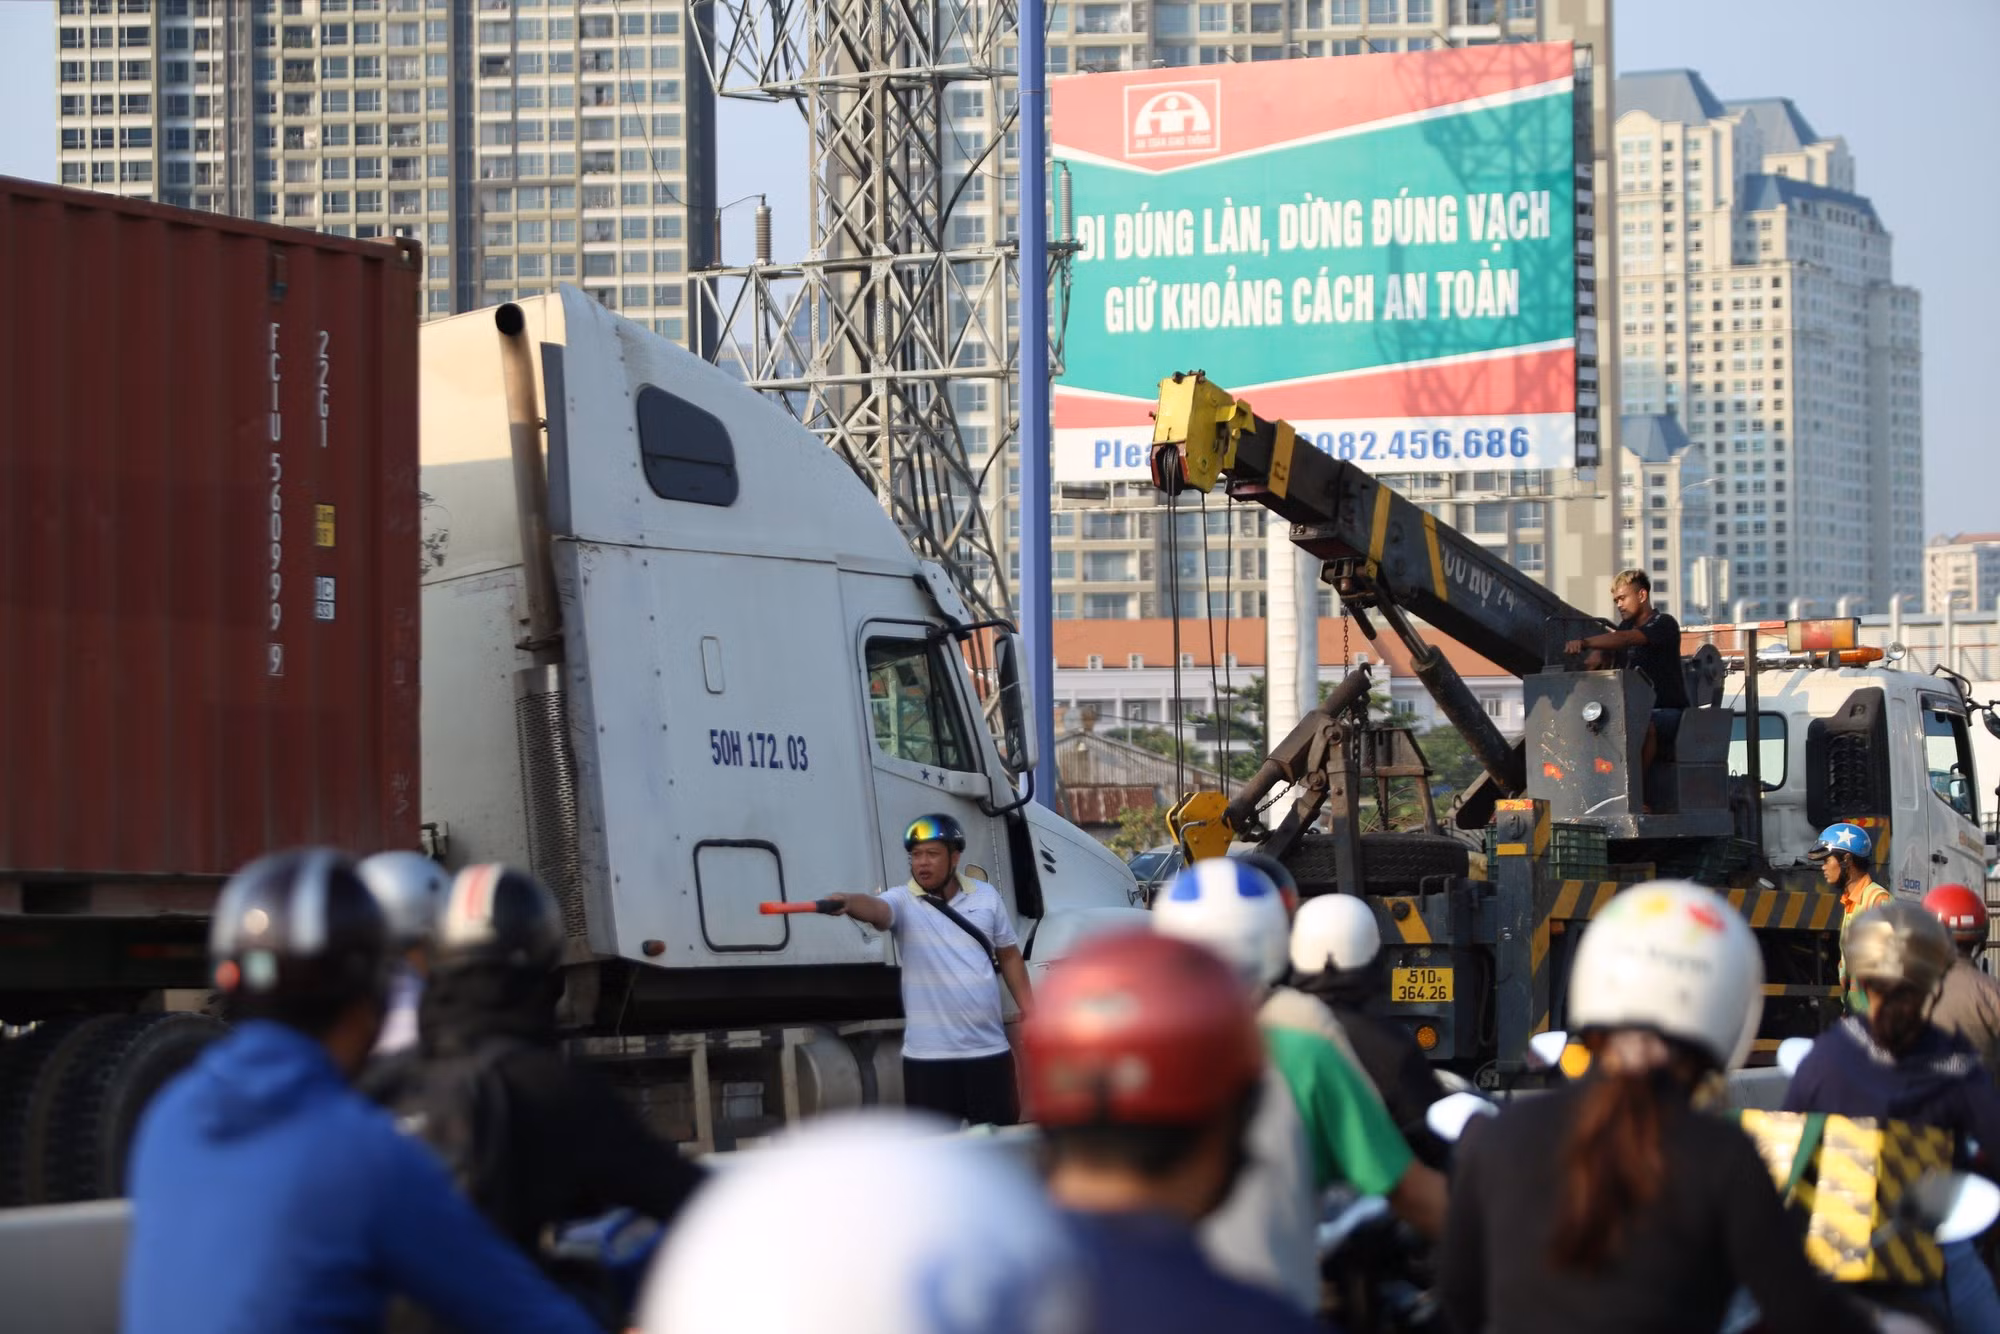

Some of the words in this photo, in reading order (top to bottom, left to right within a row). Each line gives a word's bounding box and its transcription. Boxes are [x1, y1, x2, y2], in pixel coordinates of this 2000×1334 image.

[1076, 215, 1106, 262] ĐI
[1114, 202, 1195, 260] ĐÚNG
[1203, 197, 1270, 258] LÀN,
[1279, 191, 1363, 250] DỪNG
[1371, 187, 1459, 248] ĐÚNG
[1466, 189, 1551, 252] VẠCH
[1105, 276, 1158, 334] GIỮ
[1161, 265, 1284, 332] KHOẢNG
[1291, 266, 1375, 326] CÁCH
[1383, 271, 1428, 321] AN
[1436, 258, 1520, 320] TOÀN
[270, 322, 282, 442] FCIU
[319, 330, 330, 449] 22G1
[1298, 425, 1530, 462] 982.456.686
[270, 452, 282, 632] 560999
[710, 729, 743, 767] 50H
[747, 731, 784, 768] 172.
[787, 734, 809, 771] 03
[1398, 985, 1447, 1000] 364.26
